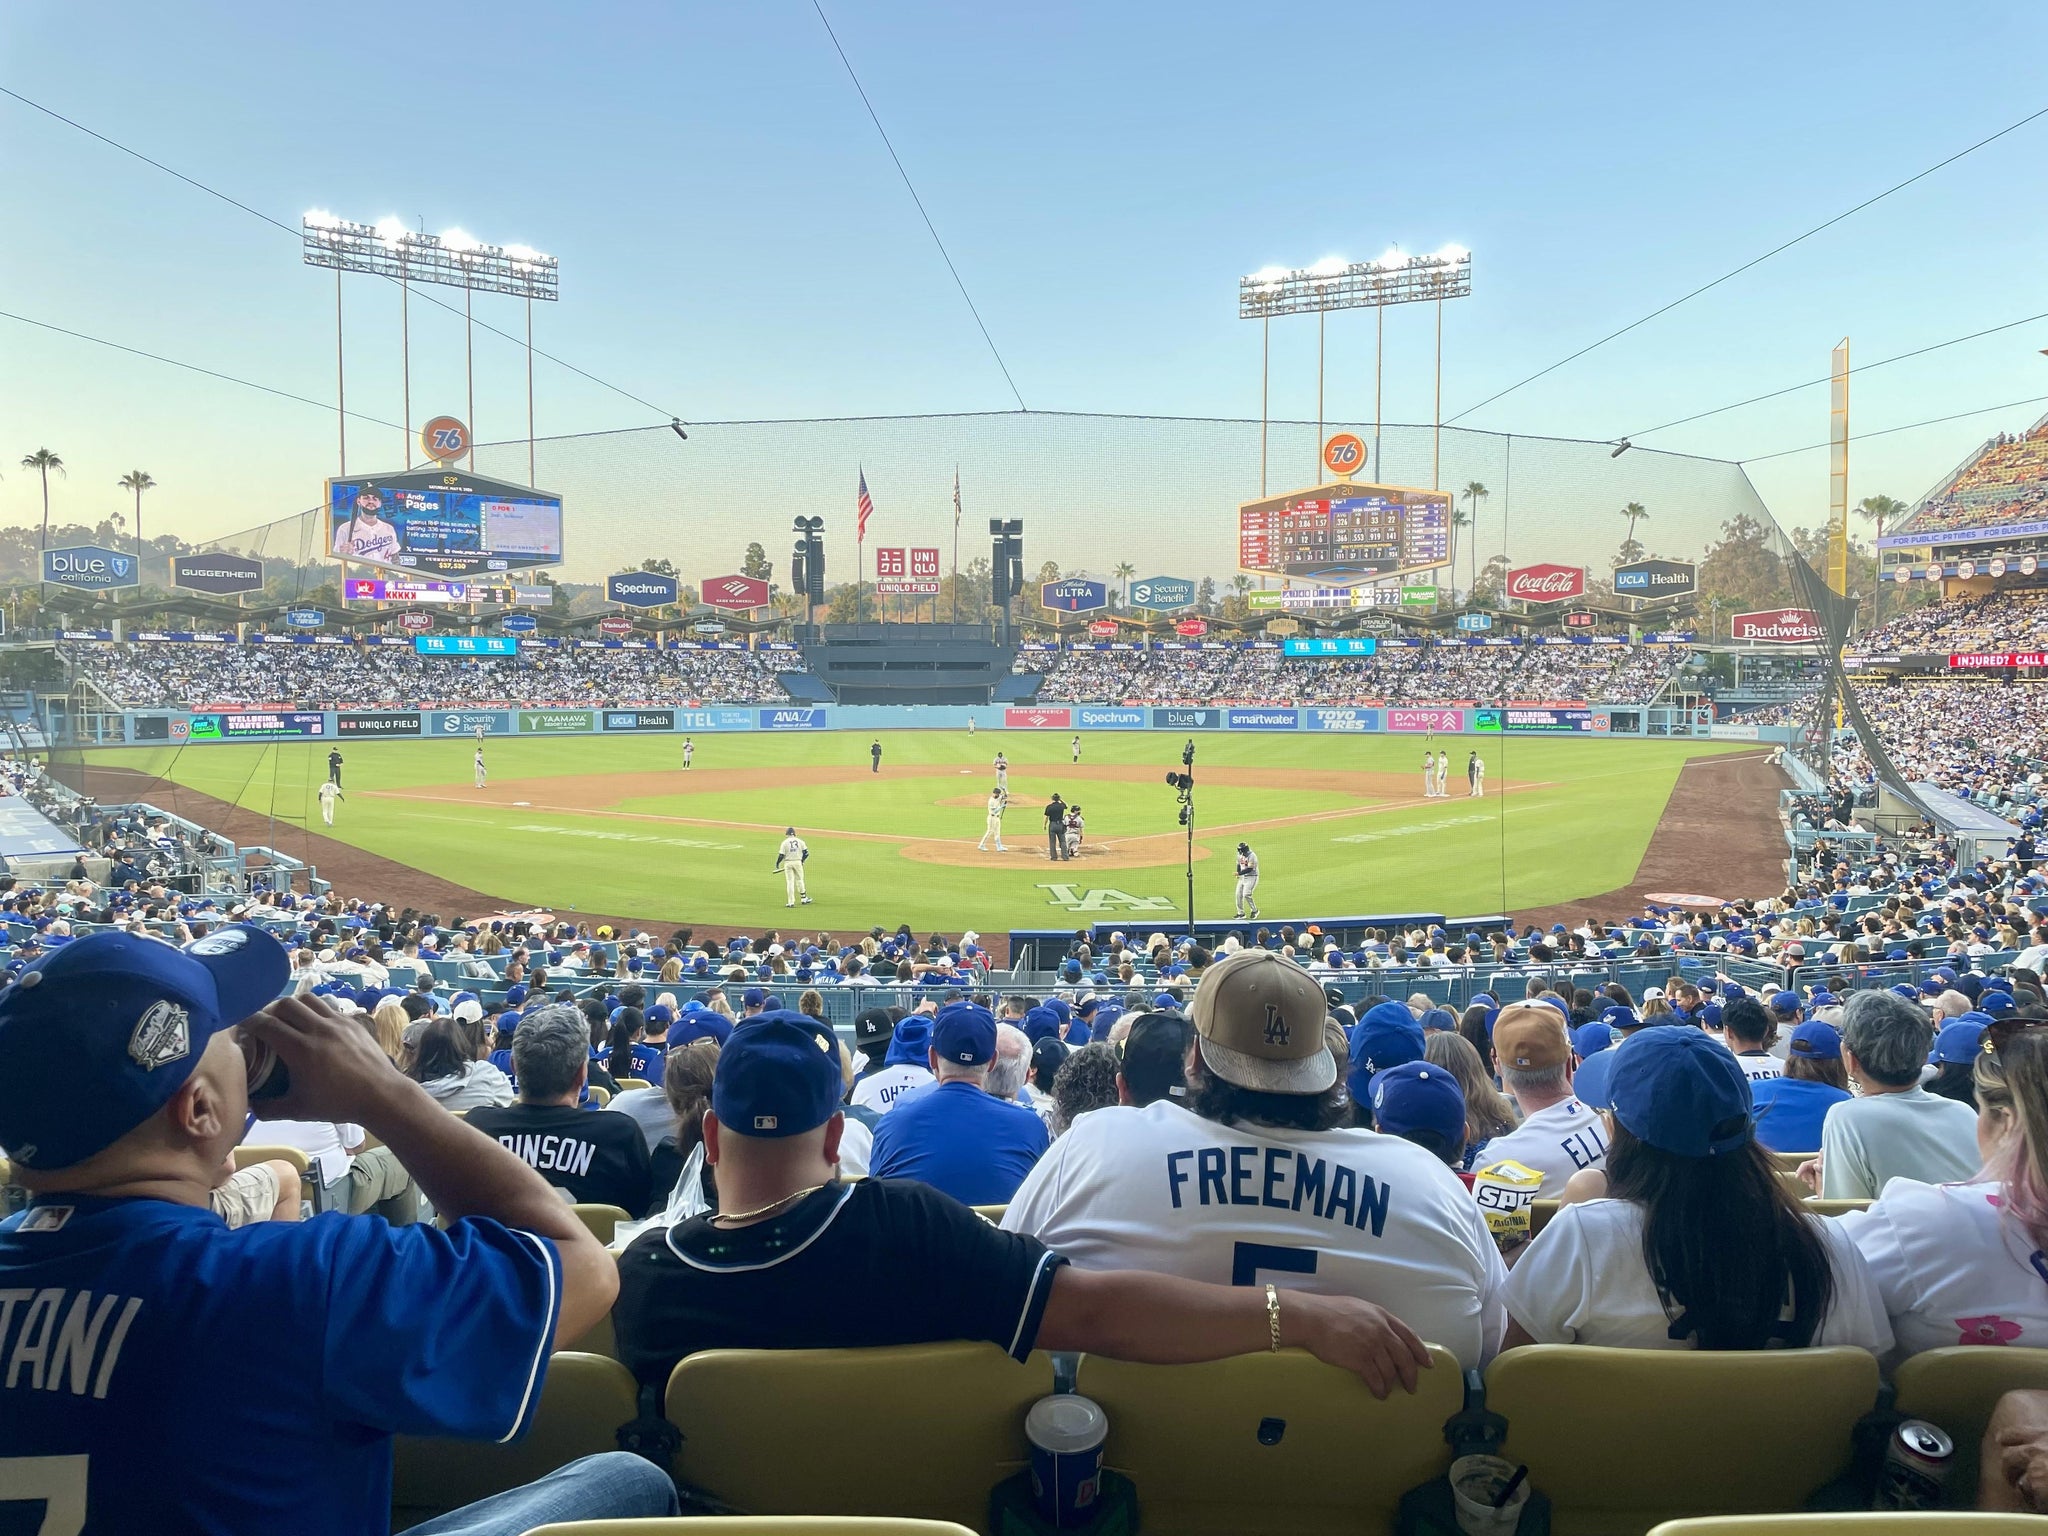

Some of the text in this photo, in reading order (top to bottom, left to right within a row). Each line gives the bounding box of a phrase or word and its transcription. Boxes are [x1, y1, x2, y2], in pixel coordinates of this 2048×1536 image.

[433, 429, 461, 450] 76
[1331, 442, 1357, 464] 76
[1330, 487, 1354, 496] 7:20
[406, 493, 425, 502] Andy
[406, 501, 439, 512] Pages
[406, 519, 426, 527] Against
[406, 526, 424, 534] batting
[1911, 534, 1939, 544] PUBLIC
[1943, 532, 1976, 540] PRTIMES
[1984, 529, 2000, 537] FOR
[2001, 526, 2038, 535] BUSINESS
[1302, 536, 1308, 544] 12
[1386, 532, 1396, 540] 141
[355, 534, 394, 553] Dodgers
[881, 552, 902, 562] ユニ
[914, 552, 934, 562] UNI
[1336, 552, 1344, 560] 111
[52, 552, 105, 573] blue
[881, 563, 902, 572] クロ
[182, 568, 257, 579] GUGGENHEIM
[914, 563, 936, 574] QLO
[61, 574, 112, 584] california
[1514, 572, 1577, 593] Coca-Cola
[1619, 573, 1689, 585] UCLA Health
[615, 582, 667, 596] Spectrum
[880, 584, 936, 593] UNIQLO FIELD
[1056, 588, 1092, 597] ULTRA
[1154, 585, 1190, 594] Security
[1154, 594, 1186, 602] Benefit
[1376, 592, 1399, 604] 2 2 2
[404, 615, 428, 624] JINRO
[1462, 618, 1487, 628] TEL
[1090, 625, 1117, 634] Churu
[427, 640, 445, 648] TEL
[457, 640, 474, 648] TEL
[488, 640, 505, 648] TEL
[1295, 642, 1310, 650] TEL
[1322, 642, 1337, 650] TEL
[1958, 656, 2010, 666] INJURED?
[2016, 656, 2040, 664] CALL
[463, 714, 496, 724] Security
[638, 716, 668, 725] Health
[684, 713, 716, 727] TEL
[774, 712, 799, 722] ANA
[1082, 712, 1135, 725] Spectrum
[1168, 712, 1194, 722] blue
[1232, 714, 1295, 725] smartwater
[1317, 711, 1356, 720] TOYO
[1394, 713, 1439, 722] DAISO
[360, 720, 418, 730] UNIQLO FIELD
[1324, 720, 1366, 730] TIRES
[1595, 718, 1608, 727] 76
[173, 724, 187, 733] 76
[1033, 883, 1178, 912] LA
[866, 1020, 877, 1032] LA
[1264, 1004, 1290, 1045] LA
[1365, 1056, 1376, 1076] LA
[1168, 1146, 1390, 1238] FREEMAN
